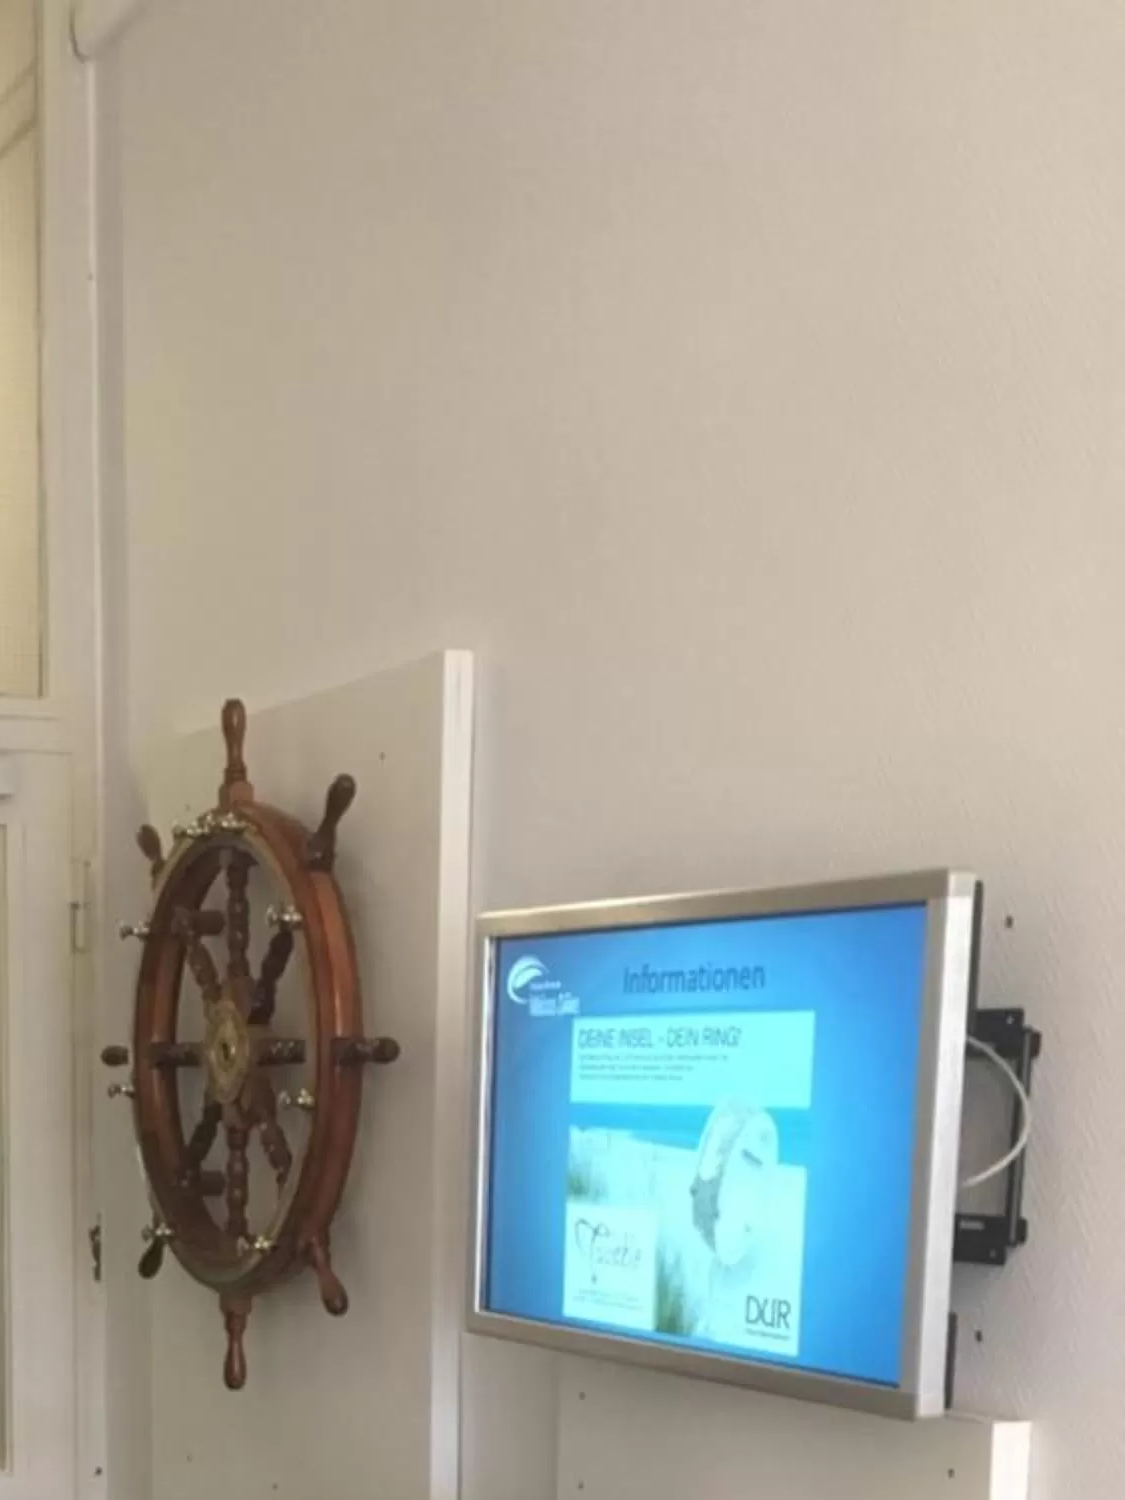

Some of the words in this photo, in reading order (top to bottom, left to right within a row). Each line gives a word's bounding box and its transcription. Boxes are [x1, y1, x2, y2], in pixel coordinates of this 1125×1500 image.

[623, 962, 766, 994] Informationen
[578, 1028, 617, 1049] DEINE
[666, 1026, 700, 1048] DEIN
